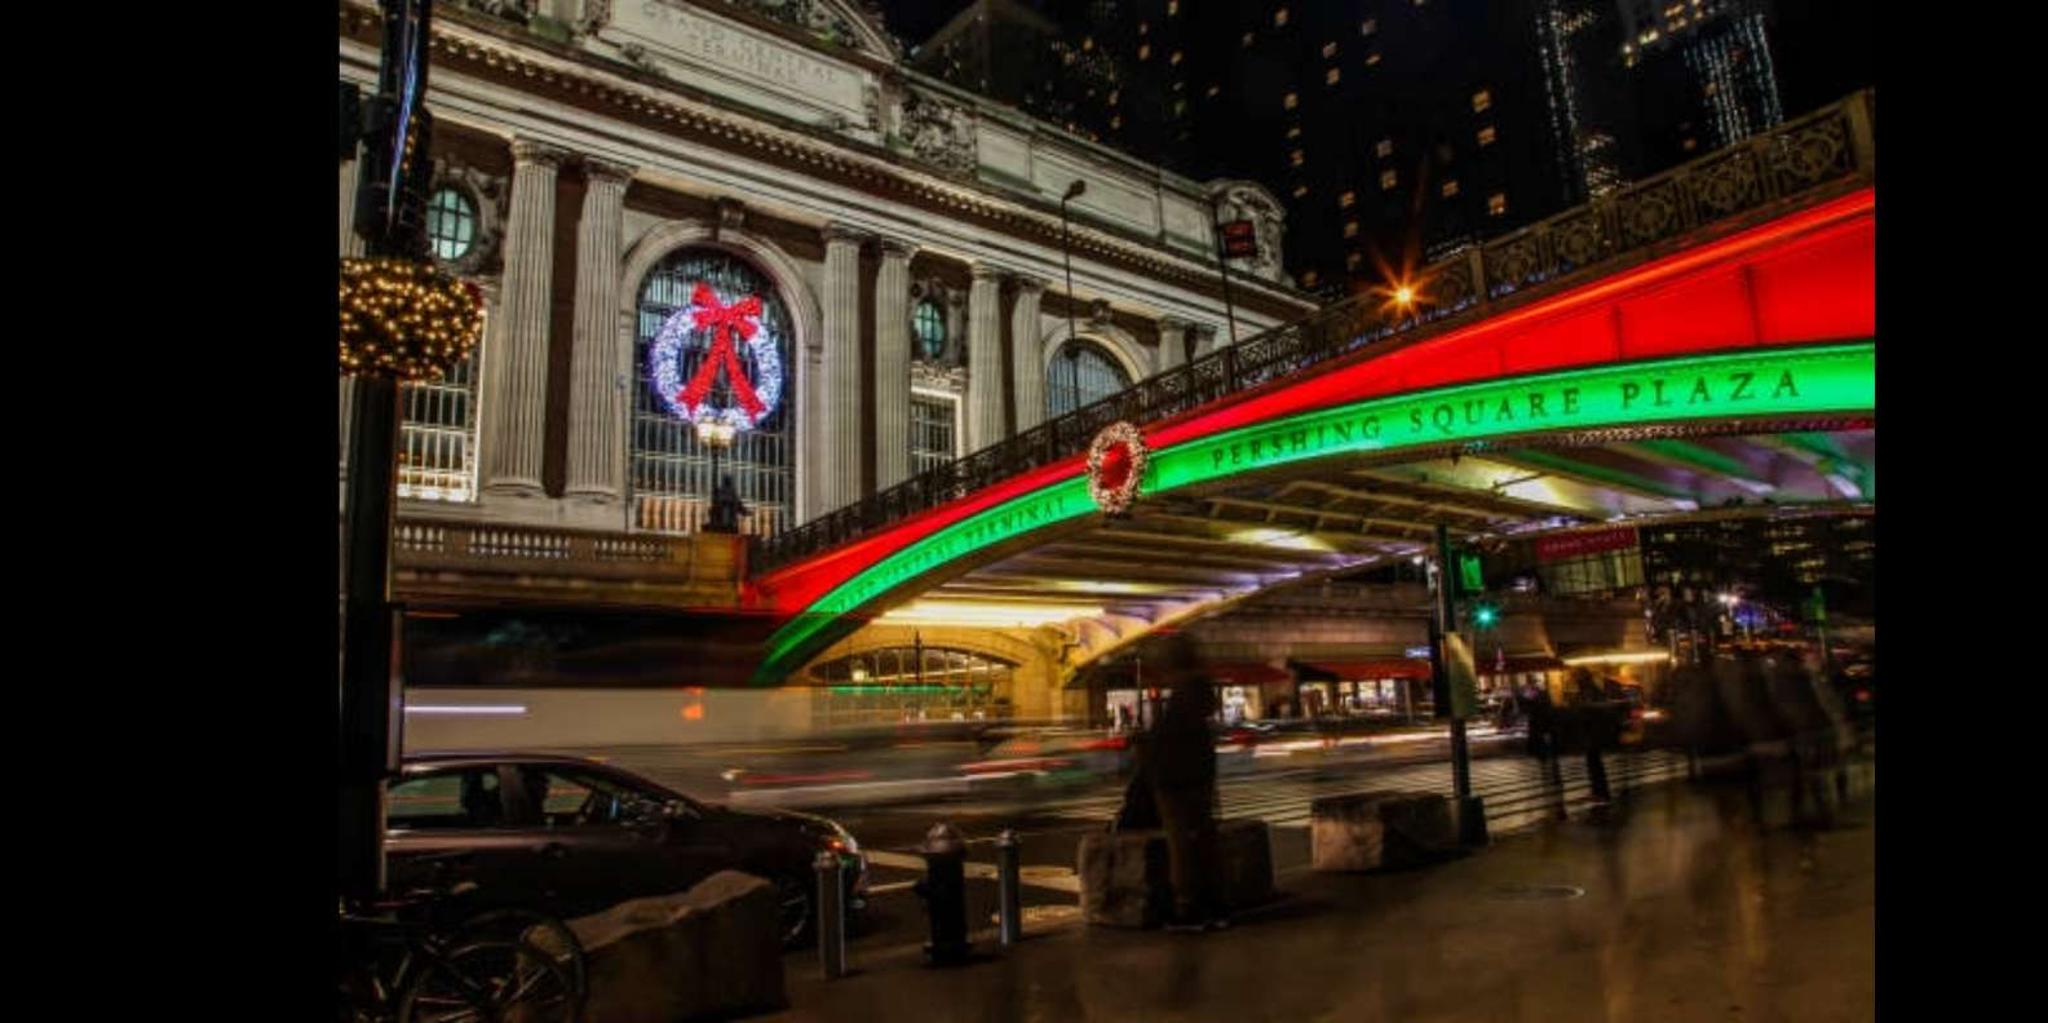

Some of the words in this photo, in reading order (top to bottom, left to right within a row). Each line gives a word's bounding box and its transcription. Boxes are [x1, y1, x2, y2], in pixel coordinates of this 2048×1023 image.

[1212, 416, 1381, 470] PERSHING
[1409, 387, 1581, 435] SQUARE
[1620, 368, 1800, 409] PLAZA
